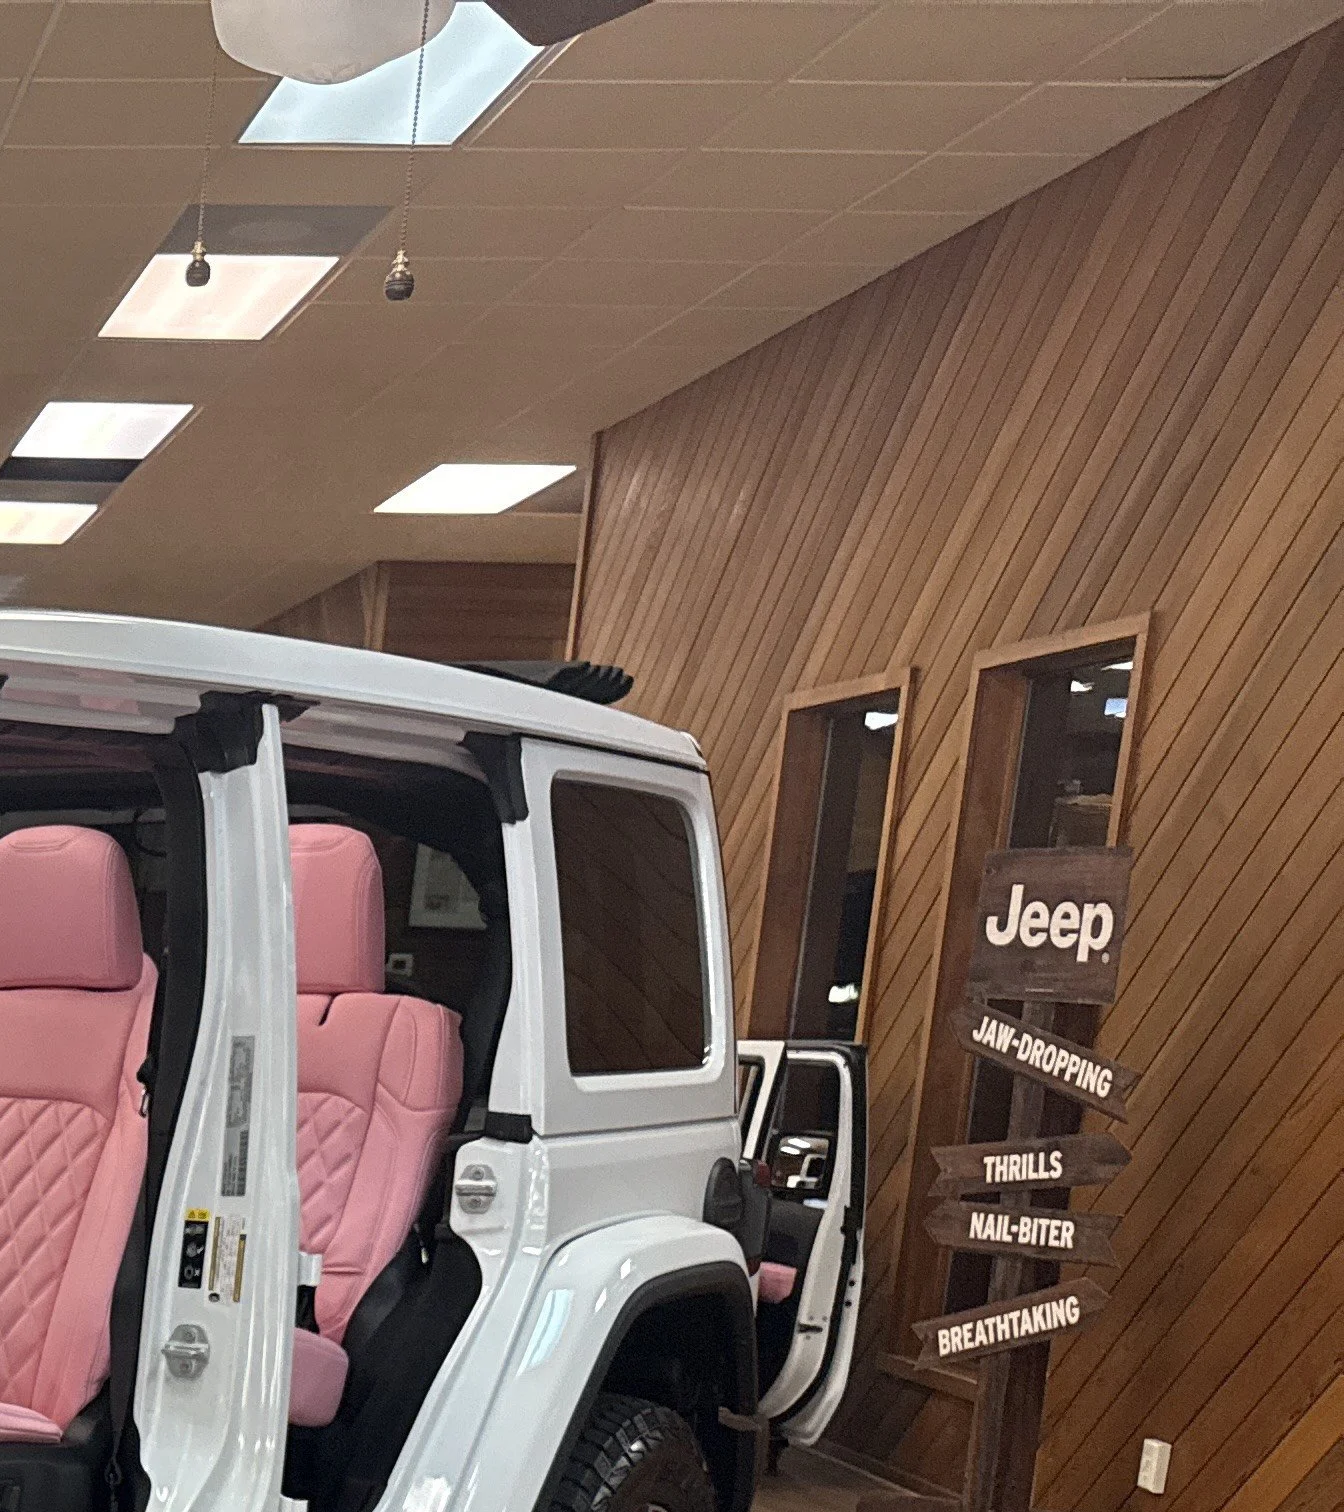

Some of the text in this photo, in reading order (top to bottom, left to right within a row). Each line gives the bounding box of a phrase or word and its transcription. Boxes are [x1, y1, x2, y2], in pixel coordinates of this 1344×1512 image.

[985, 884, 1114, 962] Jeep
[972, 1015, 1113, 1099] JAW-DROPPING
[983, 1150, 1063, 1184] THRILLS
[968, 1211, 1075, 1250] NAIL-BITER
[937, 1295, 1081, 1358] BREATHTAKING
